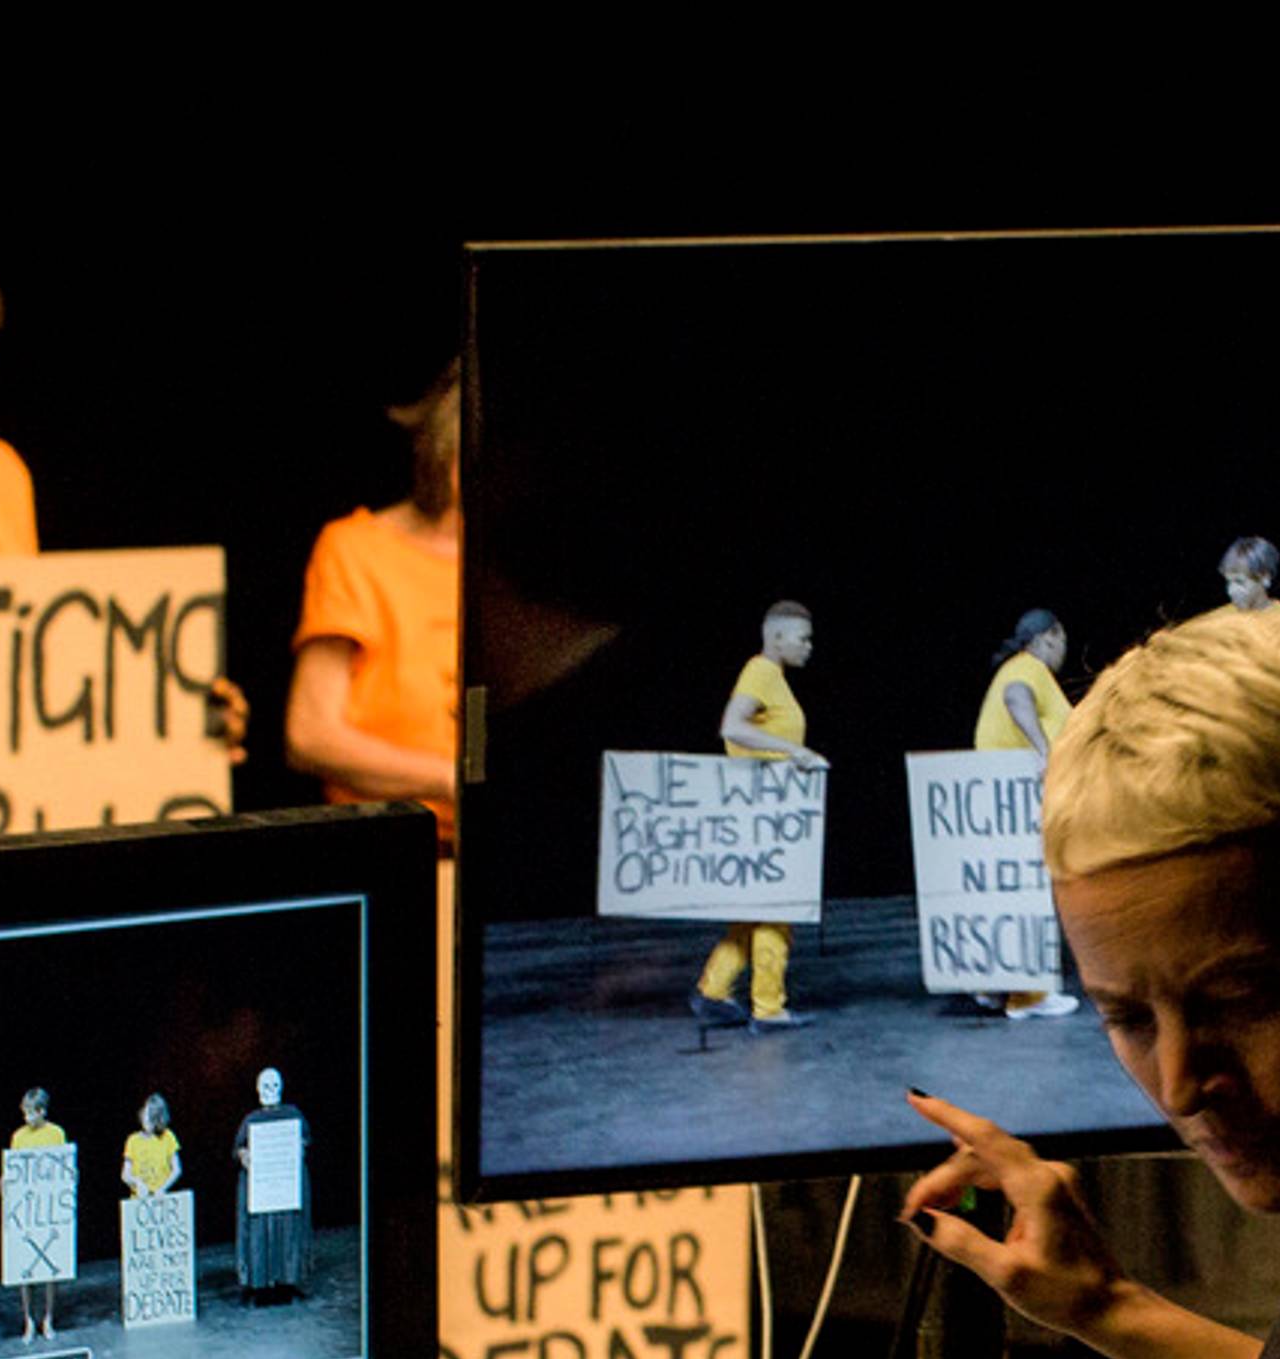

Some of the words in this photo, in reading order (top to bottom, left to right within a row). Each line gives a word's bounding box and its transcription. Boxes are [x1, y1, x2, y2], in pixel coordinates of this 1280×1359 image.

[606, 752, 699, 807] WE
[962, 859, 1046, 892] NOT
[929, 914, 1060, 977] RESCUE
[476, 1233, 571, 1323] UP
[592, 1232, 706, 1322] FOR
